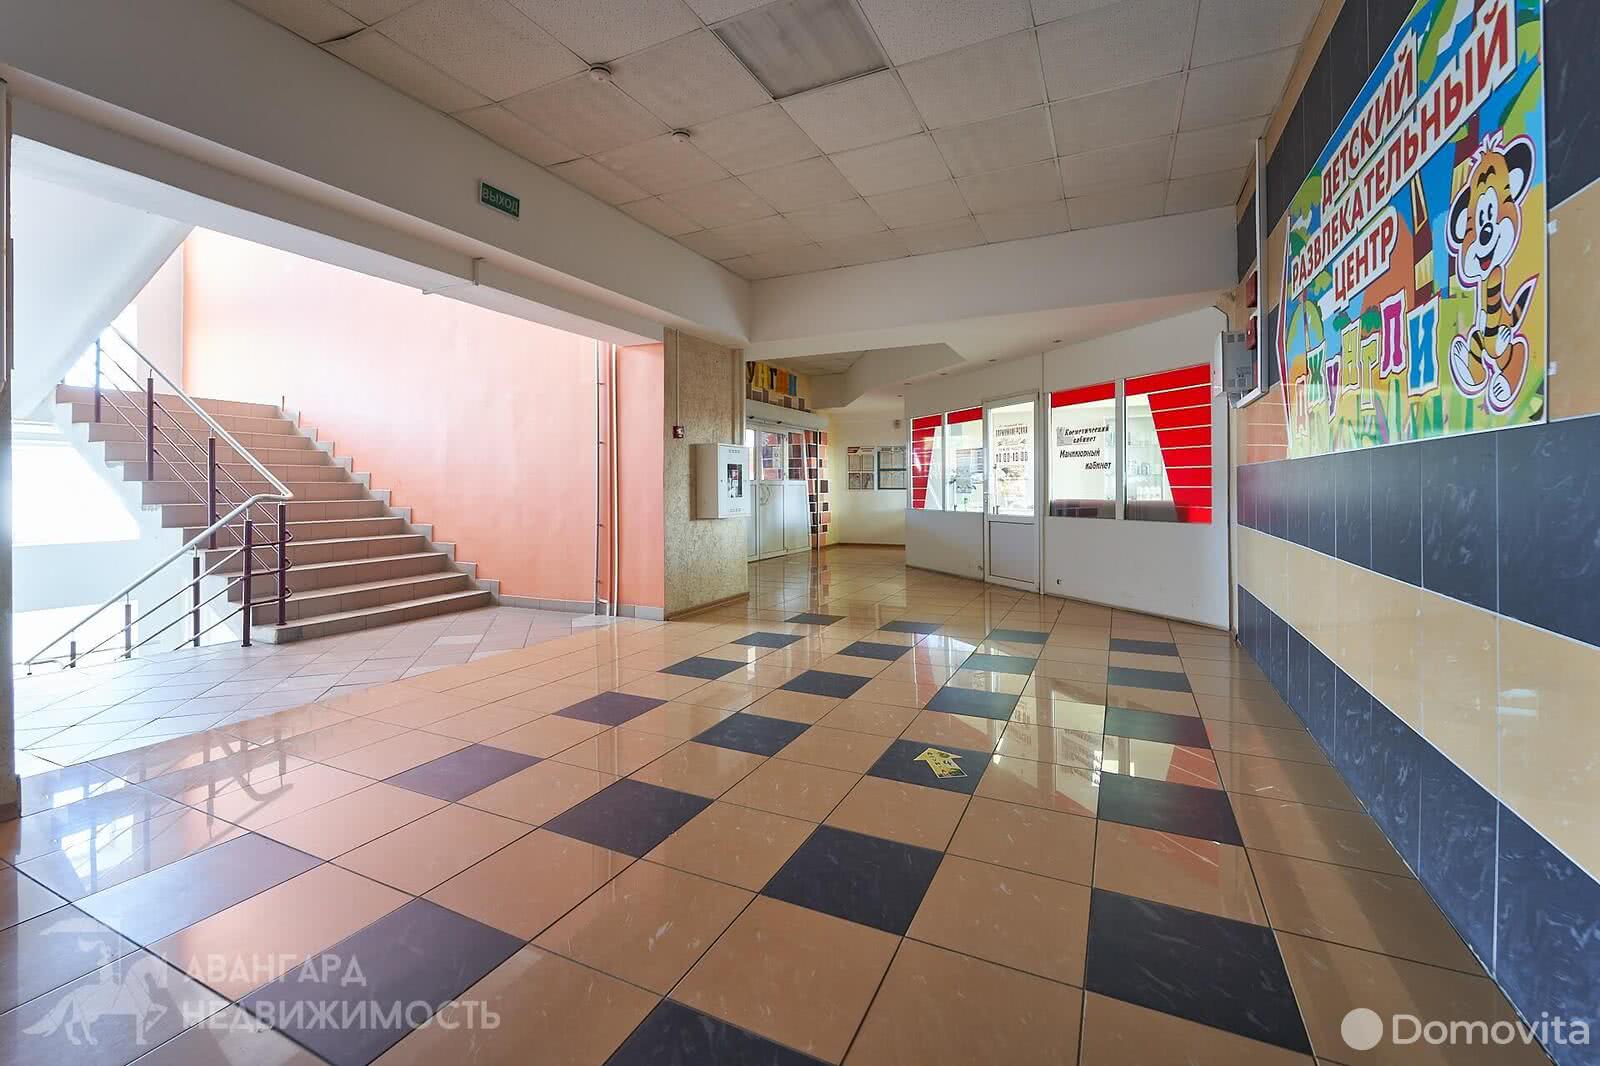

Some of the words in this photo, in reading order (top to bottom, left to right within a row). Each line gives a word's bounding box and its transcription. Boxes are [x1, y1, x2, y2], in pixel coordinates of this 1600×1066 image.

[1321, 45, 1413, 209] ДЕТСКИЙ
[1292, 0, 1509, 289] РАЗВЛЕКАТЕЛЬНЫЙ
[482, 188, 519, 217] ВЫХОД
[1333, 215, 1393, 302] ЦЕНТР
[1295, 297, 1437, 438] ДЖУНГЛИ
[1065, 424, 1109, 436] Косметический
[1073, 436, 1096, 444] кабинет
[1060, 448, 1100, 458] Маникюрный
[1085, 461, 1111, 470] кабинет
